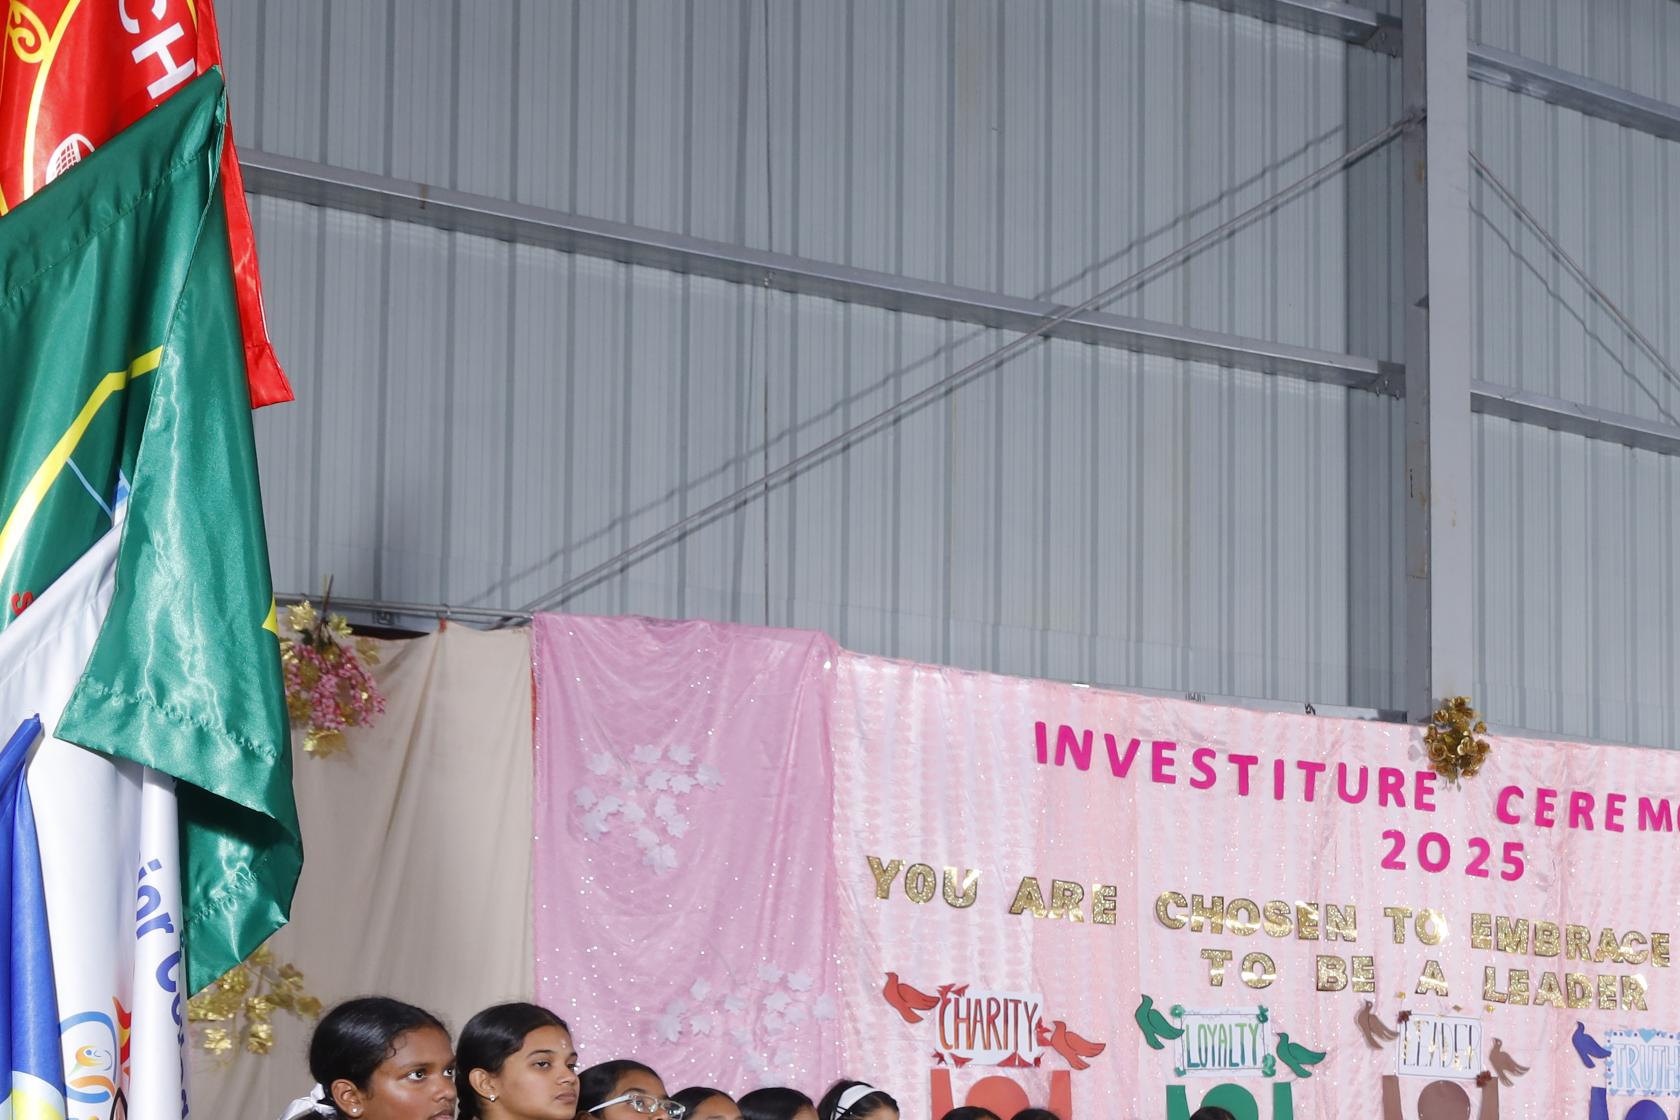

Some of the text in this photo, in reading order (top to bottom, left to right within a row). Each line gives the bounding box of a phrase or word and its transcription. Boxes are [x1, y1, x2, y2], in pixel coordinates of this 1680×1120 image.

[1034, 720, 1438, 813] INVESTITURE
[1380, 829, 1525, 882] 2025
[866, 855, 980, 909] YOU
[1009, 876, 1118, 926] ARE
[1155, 891, 1357, 942] CHOSEN
[1384, 907, 1449, 945] TO
[1471, 912, 1671, 968] EMBRACE
[1200, 948, 1649, 1011] TO BE A LEADER
[939, 996, 1039, 1052] CHARITY
[1185, 1022, 1259, 1068] LOYALTY
[1613, 1043, 1680, 1090] TRUTH
